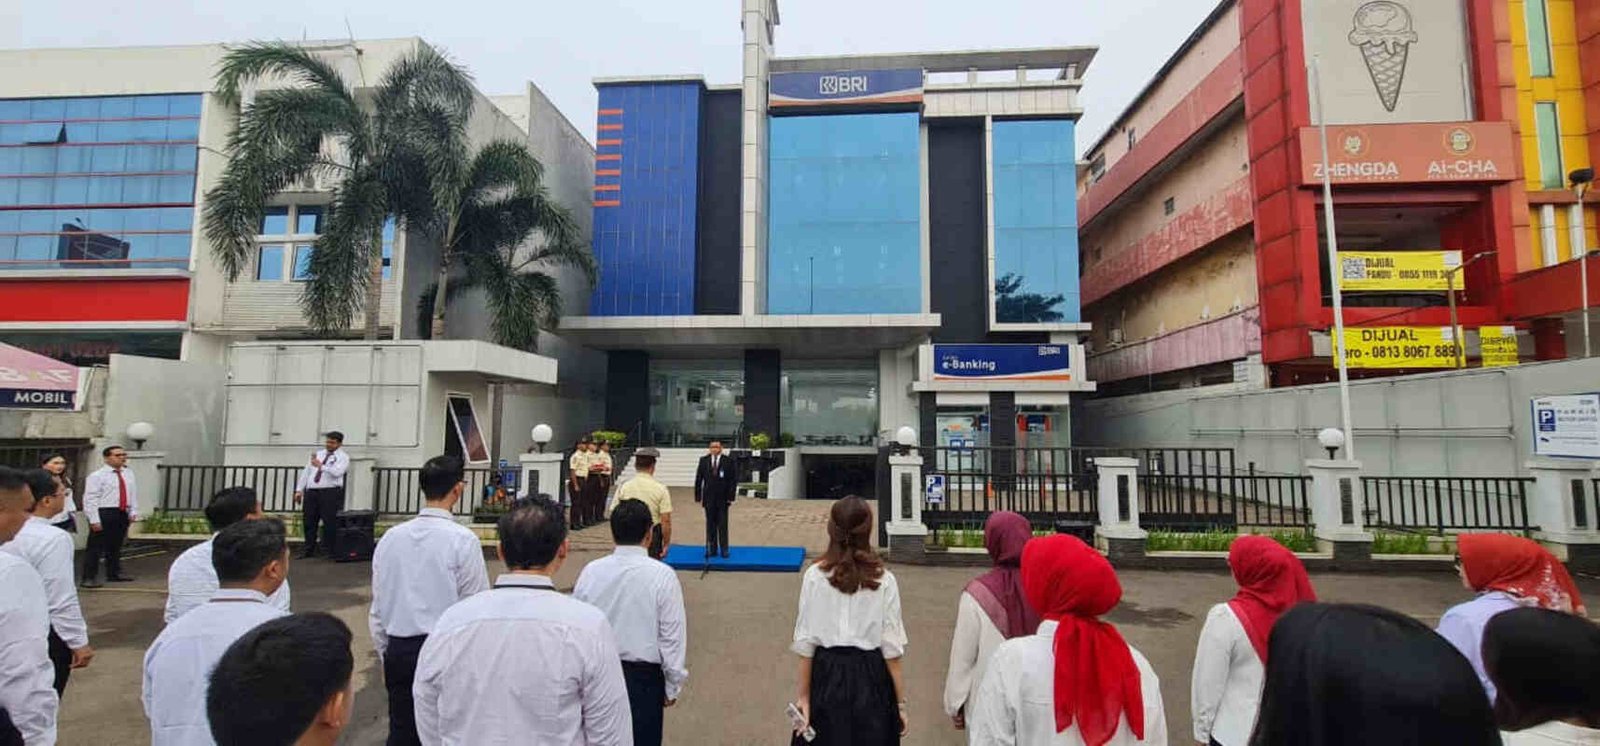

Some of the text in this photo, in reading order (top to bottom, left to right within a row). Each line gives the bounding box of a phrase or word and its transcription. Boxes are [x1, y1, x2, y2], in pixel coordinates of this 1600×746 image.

[839, 76, 867, 92] BRI
[1313, 161, 1399, 177] ZHENGDA
[1365, 257, 1395, 268] DIJUAL
[1361, 330, 1419, 342] DIJUAL
[1372, 346, 1400, 359] 0813
[1404, 346, 1431, 358] 8067
[942, 359, 996, 371] e-Banking
[14, 391, 68, 403] MOBIL
[1541, 411, 1552, 423] P
